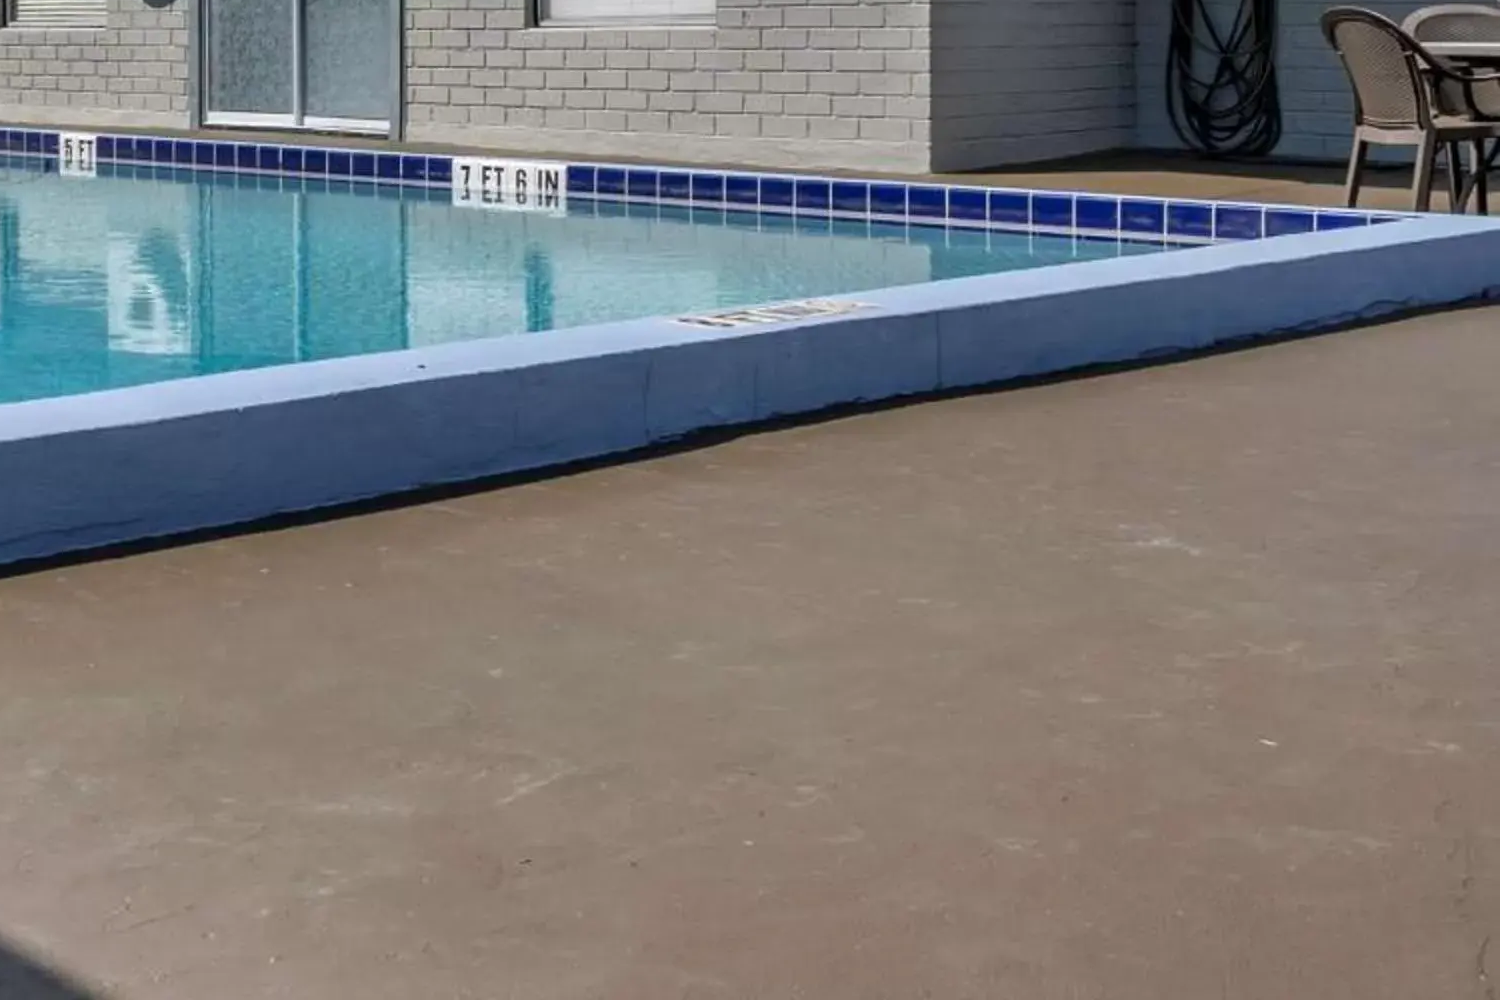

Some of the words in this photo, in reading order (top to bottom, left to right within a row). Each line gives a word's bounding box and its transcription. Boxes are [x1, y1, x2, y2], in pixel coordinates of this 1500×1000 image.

[79, 140, 94, 161] FT
[461, 166, 470, 187] 7
[482, 166, 504, 188] FT
[516, 169, 527, 191] 6
[538, 170, 558, 191] IN
